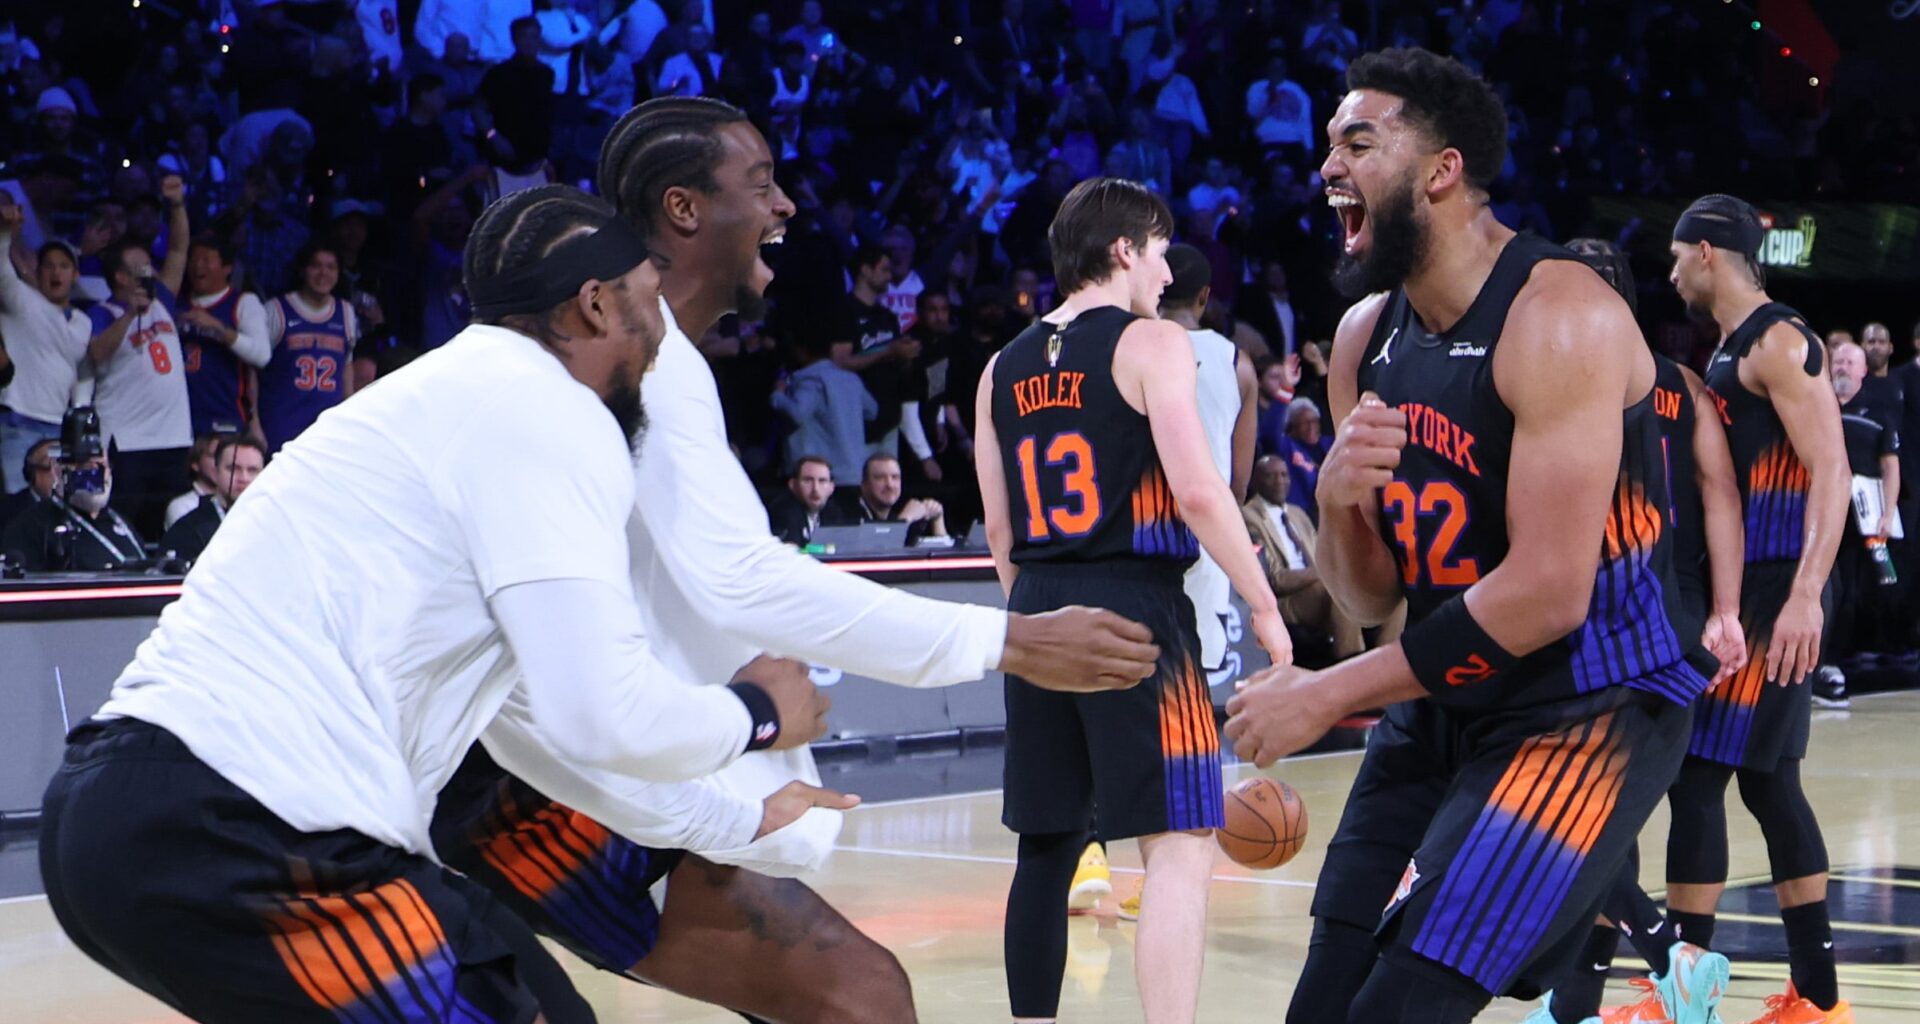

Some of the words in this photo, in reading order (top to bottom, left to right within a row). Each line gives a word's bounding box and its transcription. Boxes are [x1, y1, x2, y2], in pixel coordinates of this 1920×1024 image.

[1767, 229, 1804, 266] CUP
[148, 341, 172, 375] 8
[294, 355, 337, 391] 32
[1013, 371, 1086, 417] KOLEK
[1407, 402, 1481, 477] YORK
[1016, 430, 1102, 542] 13
[1382, 478, 1481, 587] 32
